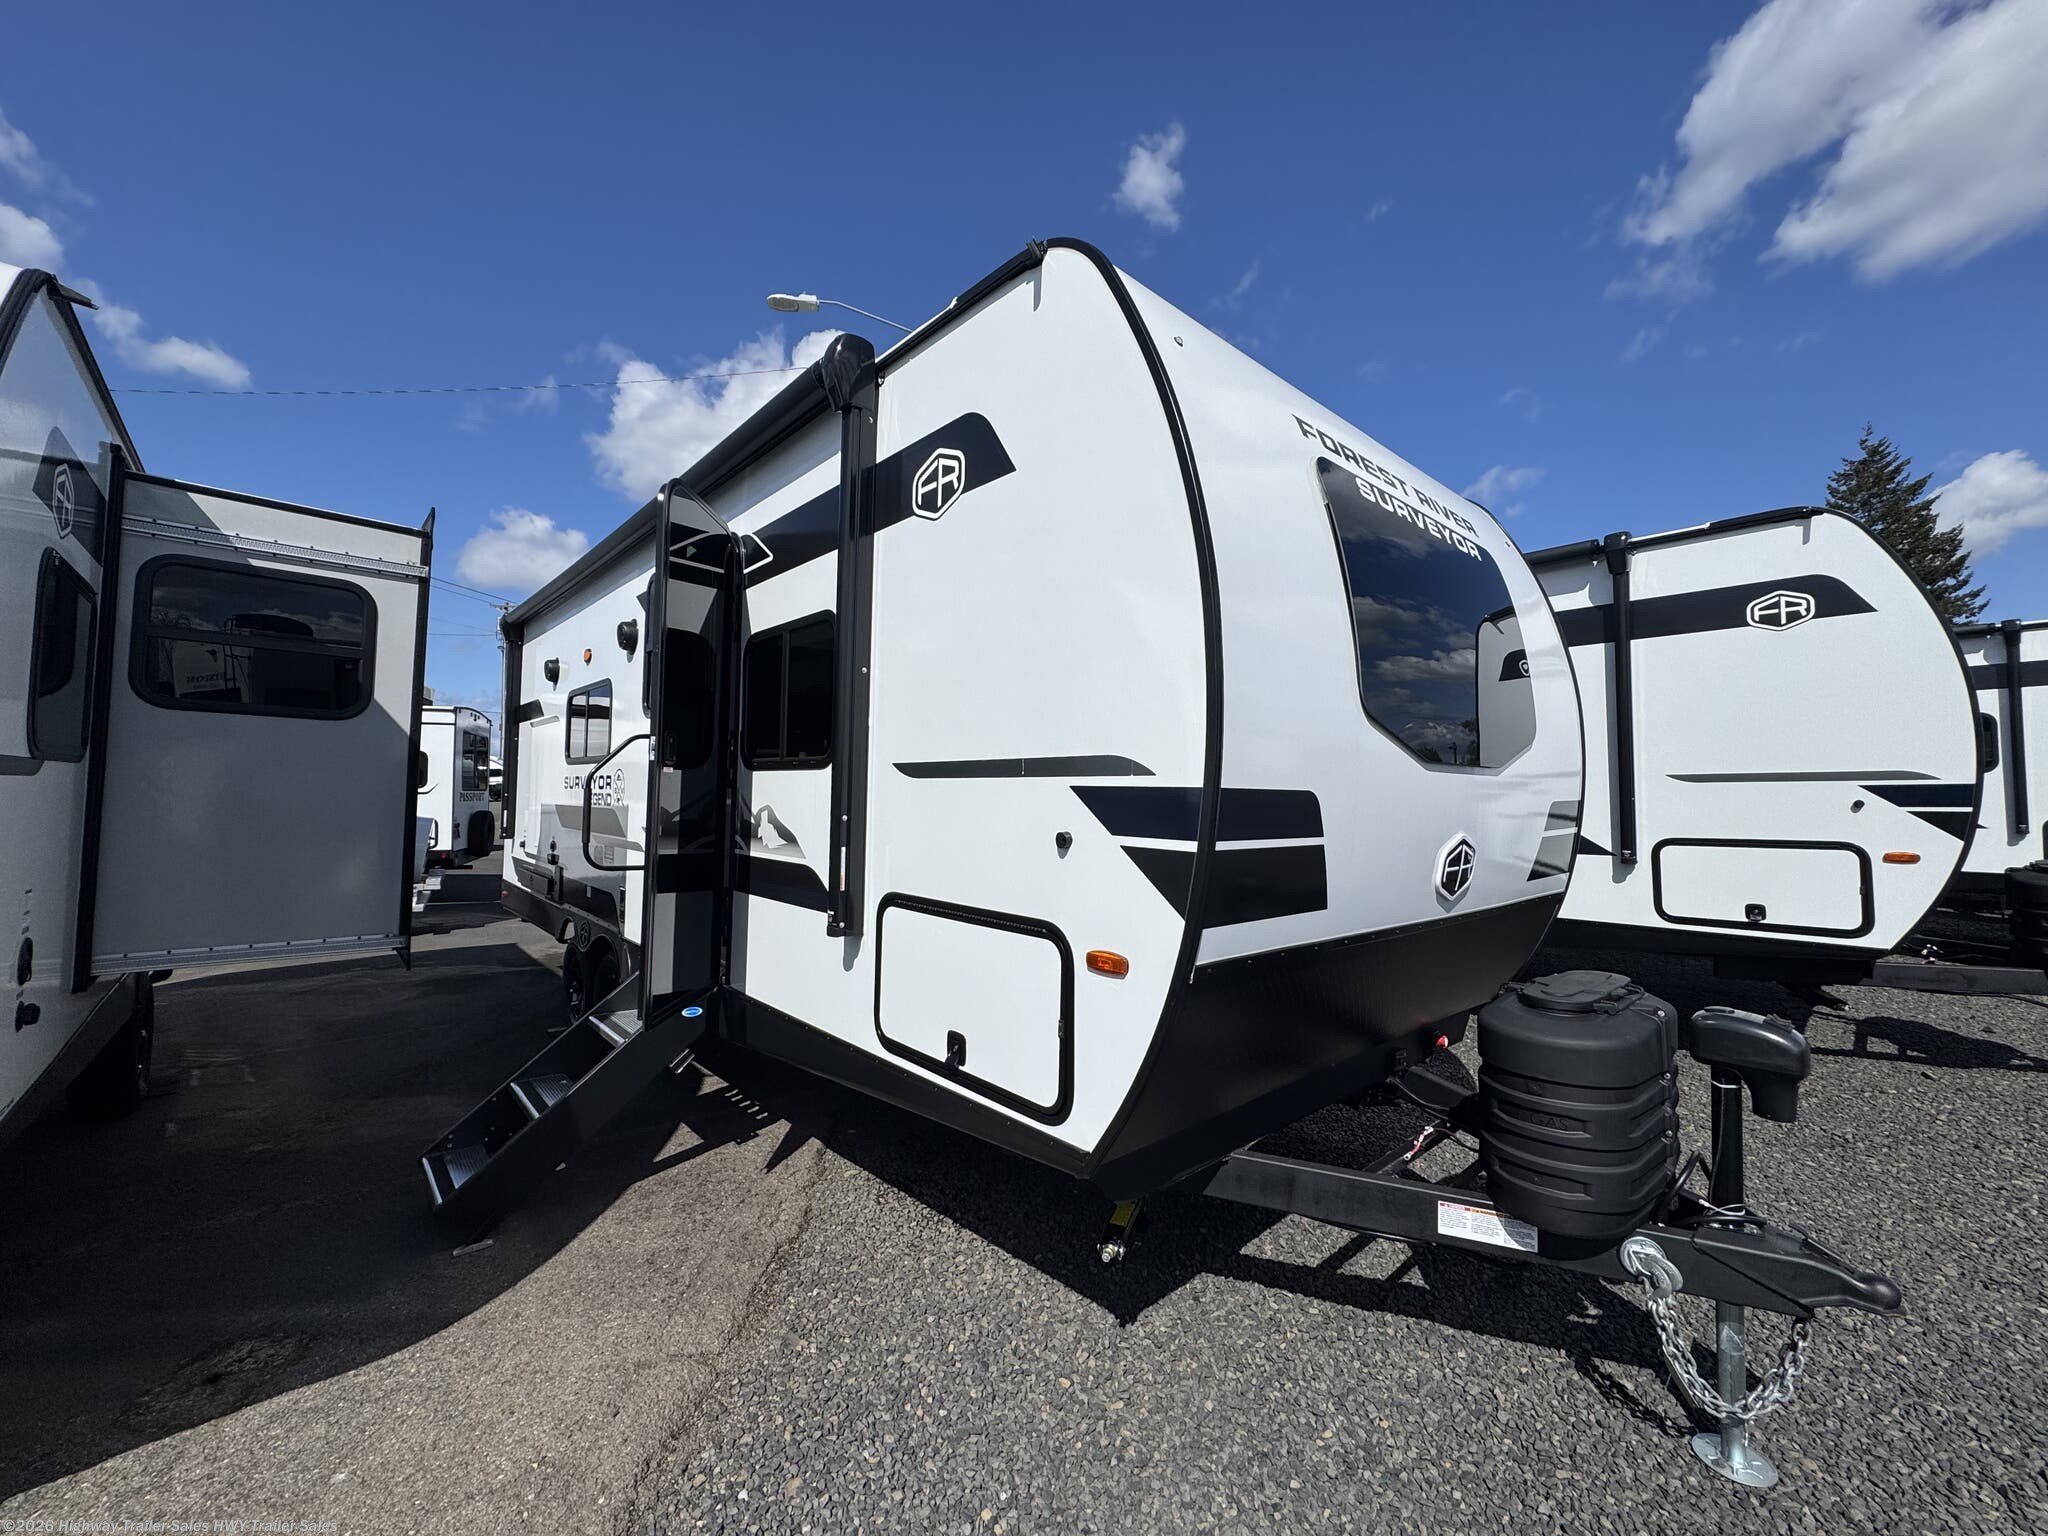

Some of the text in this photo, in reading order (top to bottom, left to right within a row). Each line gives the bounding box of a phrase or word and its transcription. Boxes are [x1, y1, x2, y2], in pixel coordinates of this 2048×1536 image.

[1291, 413, 1480, 538] FOREST RIVER
[1355, 476, 1482, 561] SURVEYOR
[1751, 593, 1810, 626] FR
[563, 775, 612, 790] SURVYOR
[592, 792, 612, 806] GEND
